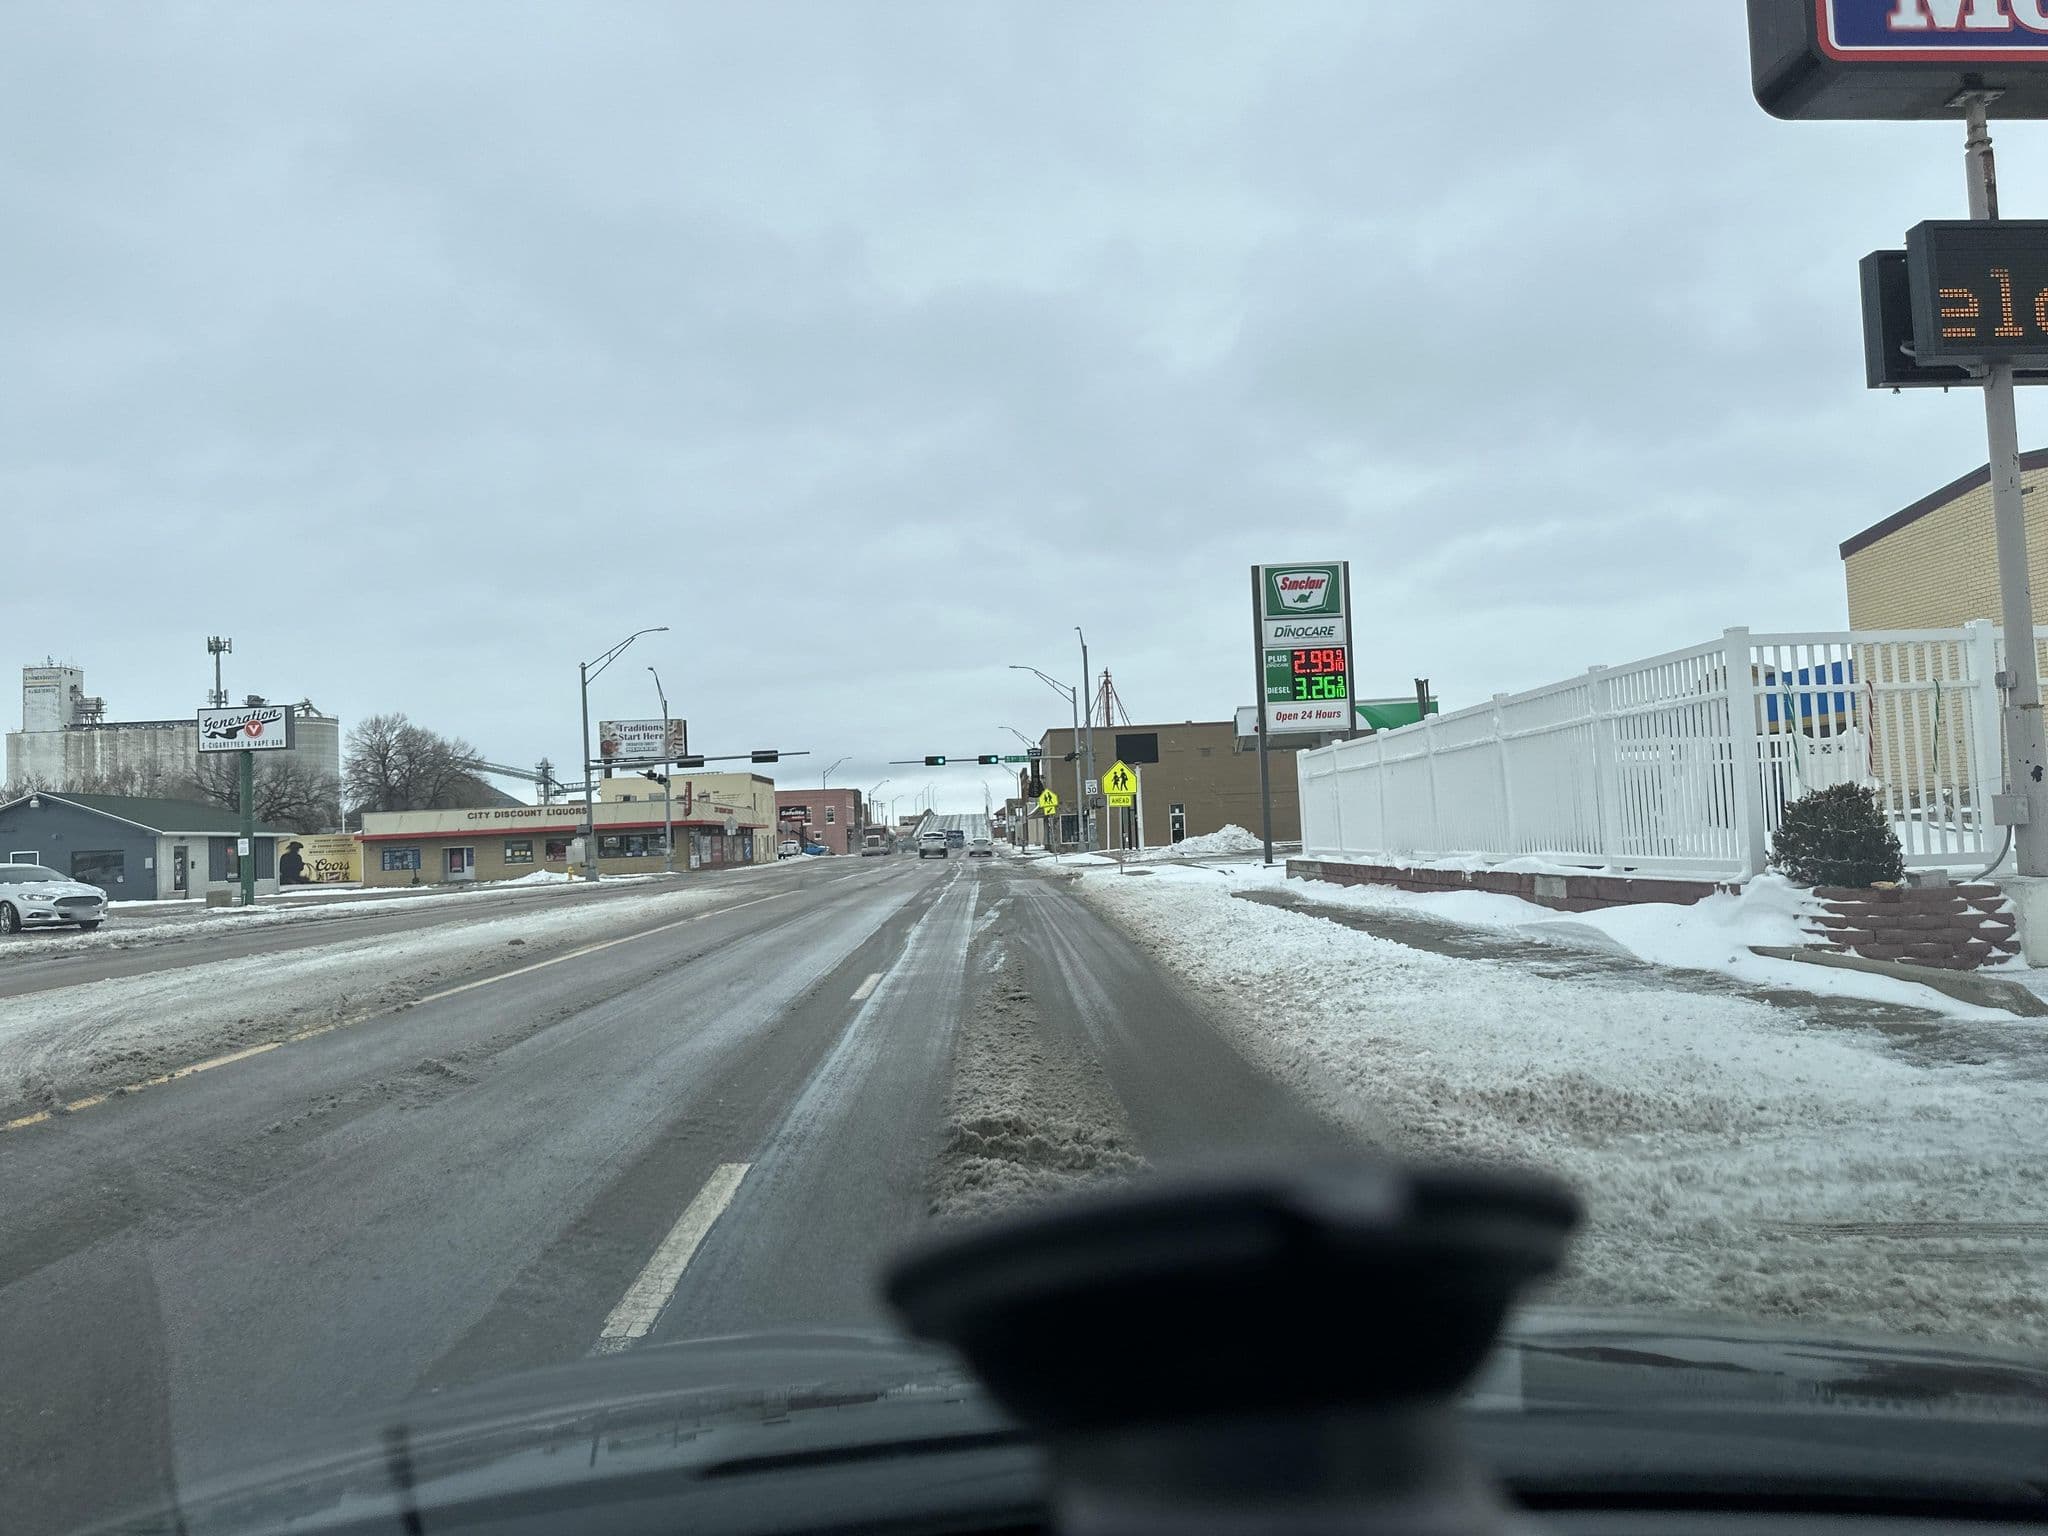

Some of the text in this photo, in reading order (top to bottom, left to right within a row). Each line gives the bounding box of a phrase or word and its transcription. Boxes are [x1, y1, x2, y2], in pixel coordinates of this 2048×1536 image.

[1280, 576, 1325, 591] Sinclair
[1274, 625, 1335, 637] DINOCARE
[1294, 650, 1334, 673] 2.99
[1267, 686, 1291, 694] DIESEL
[1294, 676, 1336, 700] 3.26
[201, 709, 282, 734] Generation
[1275, 709, 1342, 723] Open 24 Hours
[618, 723, 664, 732] Traditions
[619, 732, 665, 741] Start Here
[467, 806, 588, 820] CITY DISCOUNT LIQUORS
[315, 858, 350, 871] Coors
